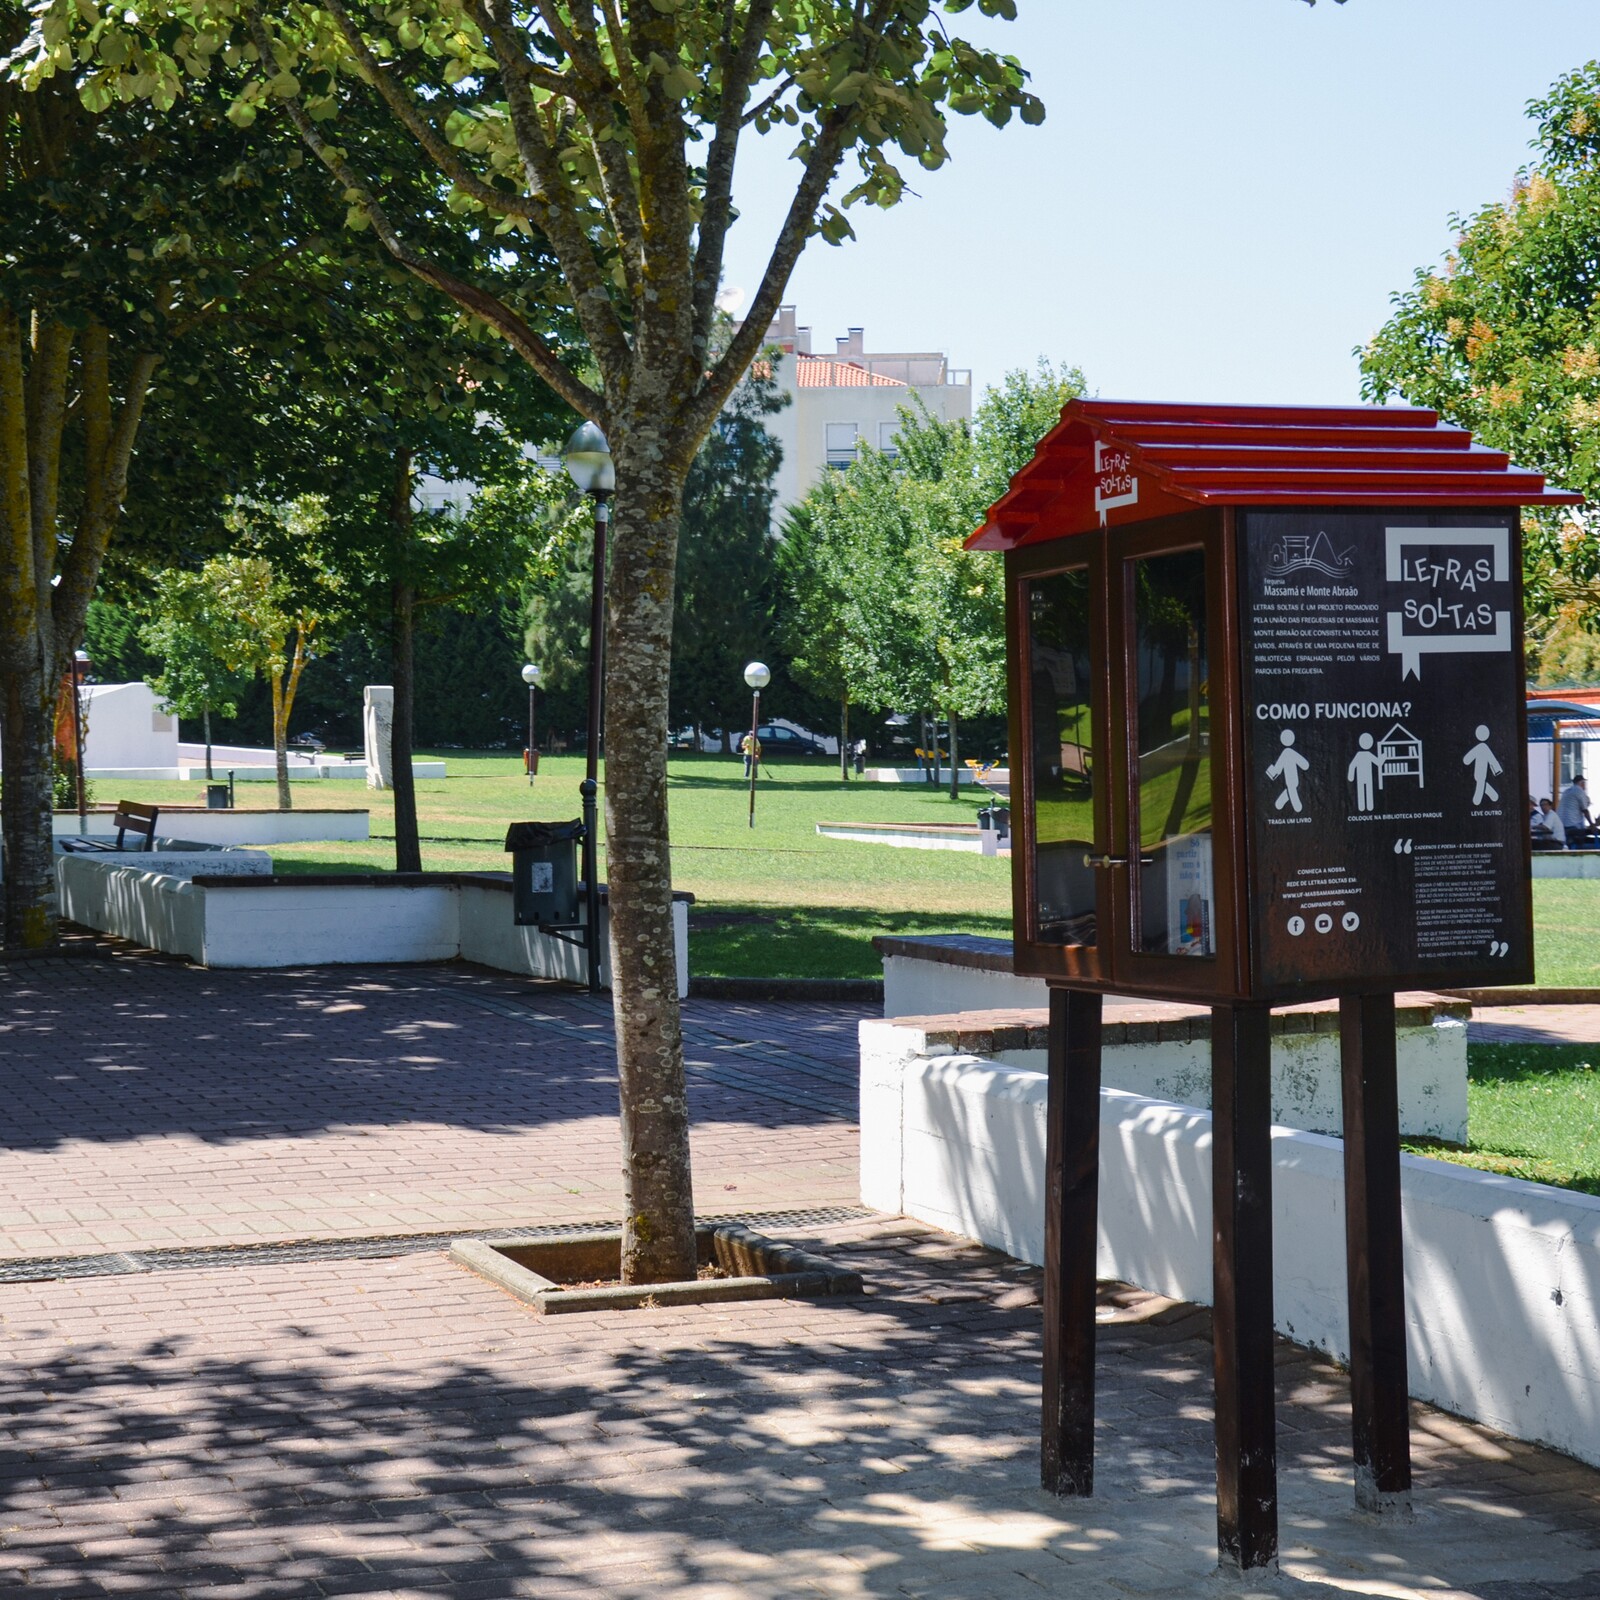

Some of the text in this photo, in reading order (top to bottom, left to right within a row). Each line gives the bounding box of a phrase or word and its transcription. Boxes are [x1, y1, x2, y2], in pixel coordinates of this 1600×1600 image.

[1100, 474, 1131, 494] SOLTAS
[1403, 557, 1492, 592] LETRAS
[1264, 586, 1358, 596] Massamá e Monte Abraão
[1404, 597, 1493, 629] SOLTAS
[1256, 702, 1412, 720] COMO FUNCIONA?
